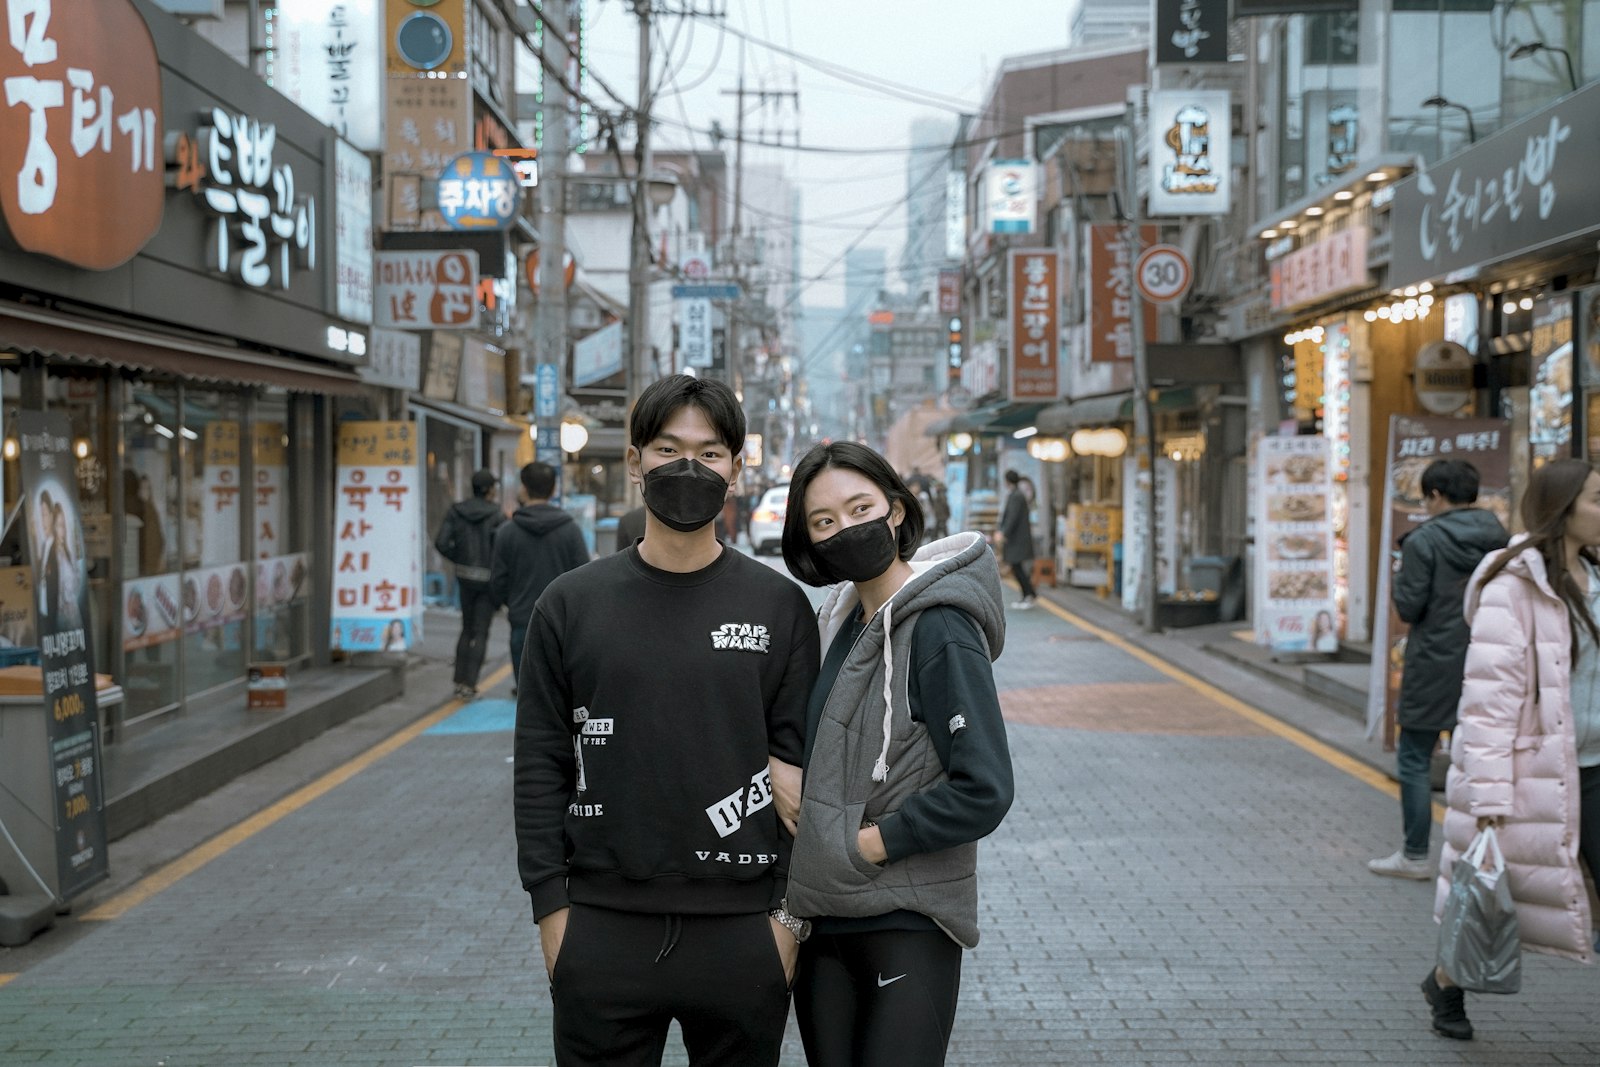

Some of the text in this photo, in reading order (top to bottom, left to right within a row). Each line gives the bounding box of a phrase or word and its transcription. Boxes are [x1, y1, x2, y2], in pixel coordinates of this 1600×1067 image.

[438, 178, 517, 218] 주차장
[1146, 261, 1180, 287] 30
[1022, 256, 1050, 367] 풍천장어
[711, 623, 768, 637] STAR
[712, 634, 770, 654] WARS
